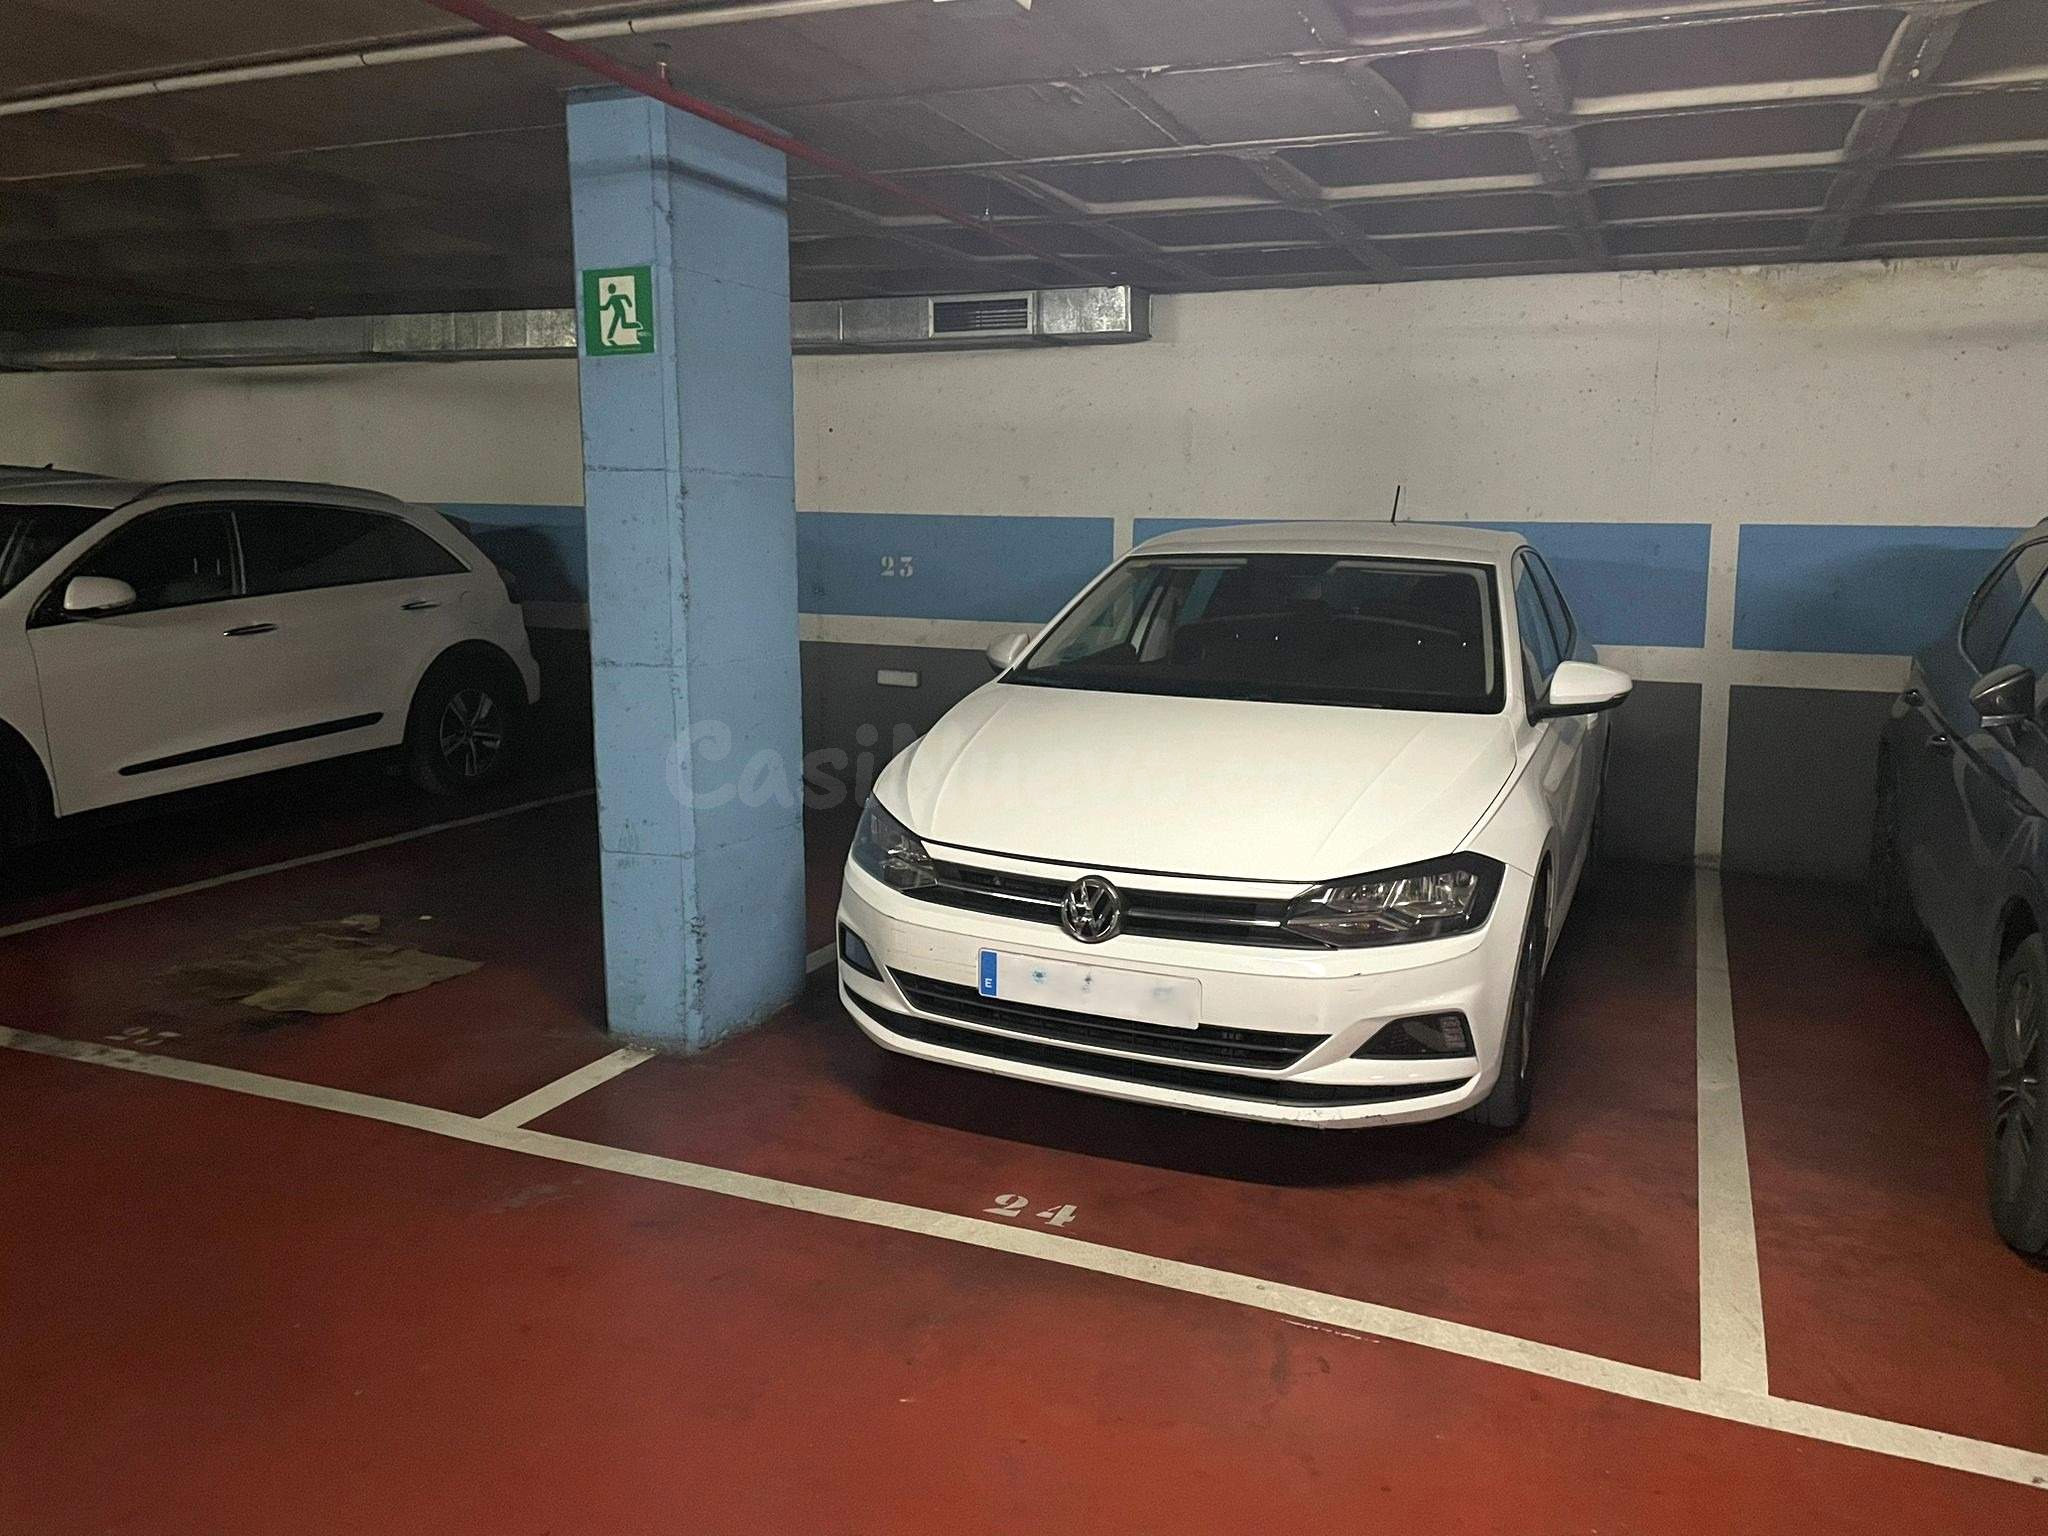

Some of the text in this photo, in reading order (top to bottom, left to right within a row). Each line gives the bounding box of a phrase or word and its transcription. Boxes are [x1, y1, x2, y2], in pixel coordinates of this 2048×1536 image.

[880, 556, 914, 576] 23
[984, 978, 993, 988] E
[982, 1194, 1077, 1227] 24
